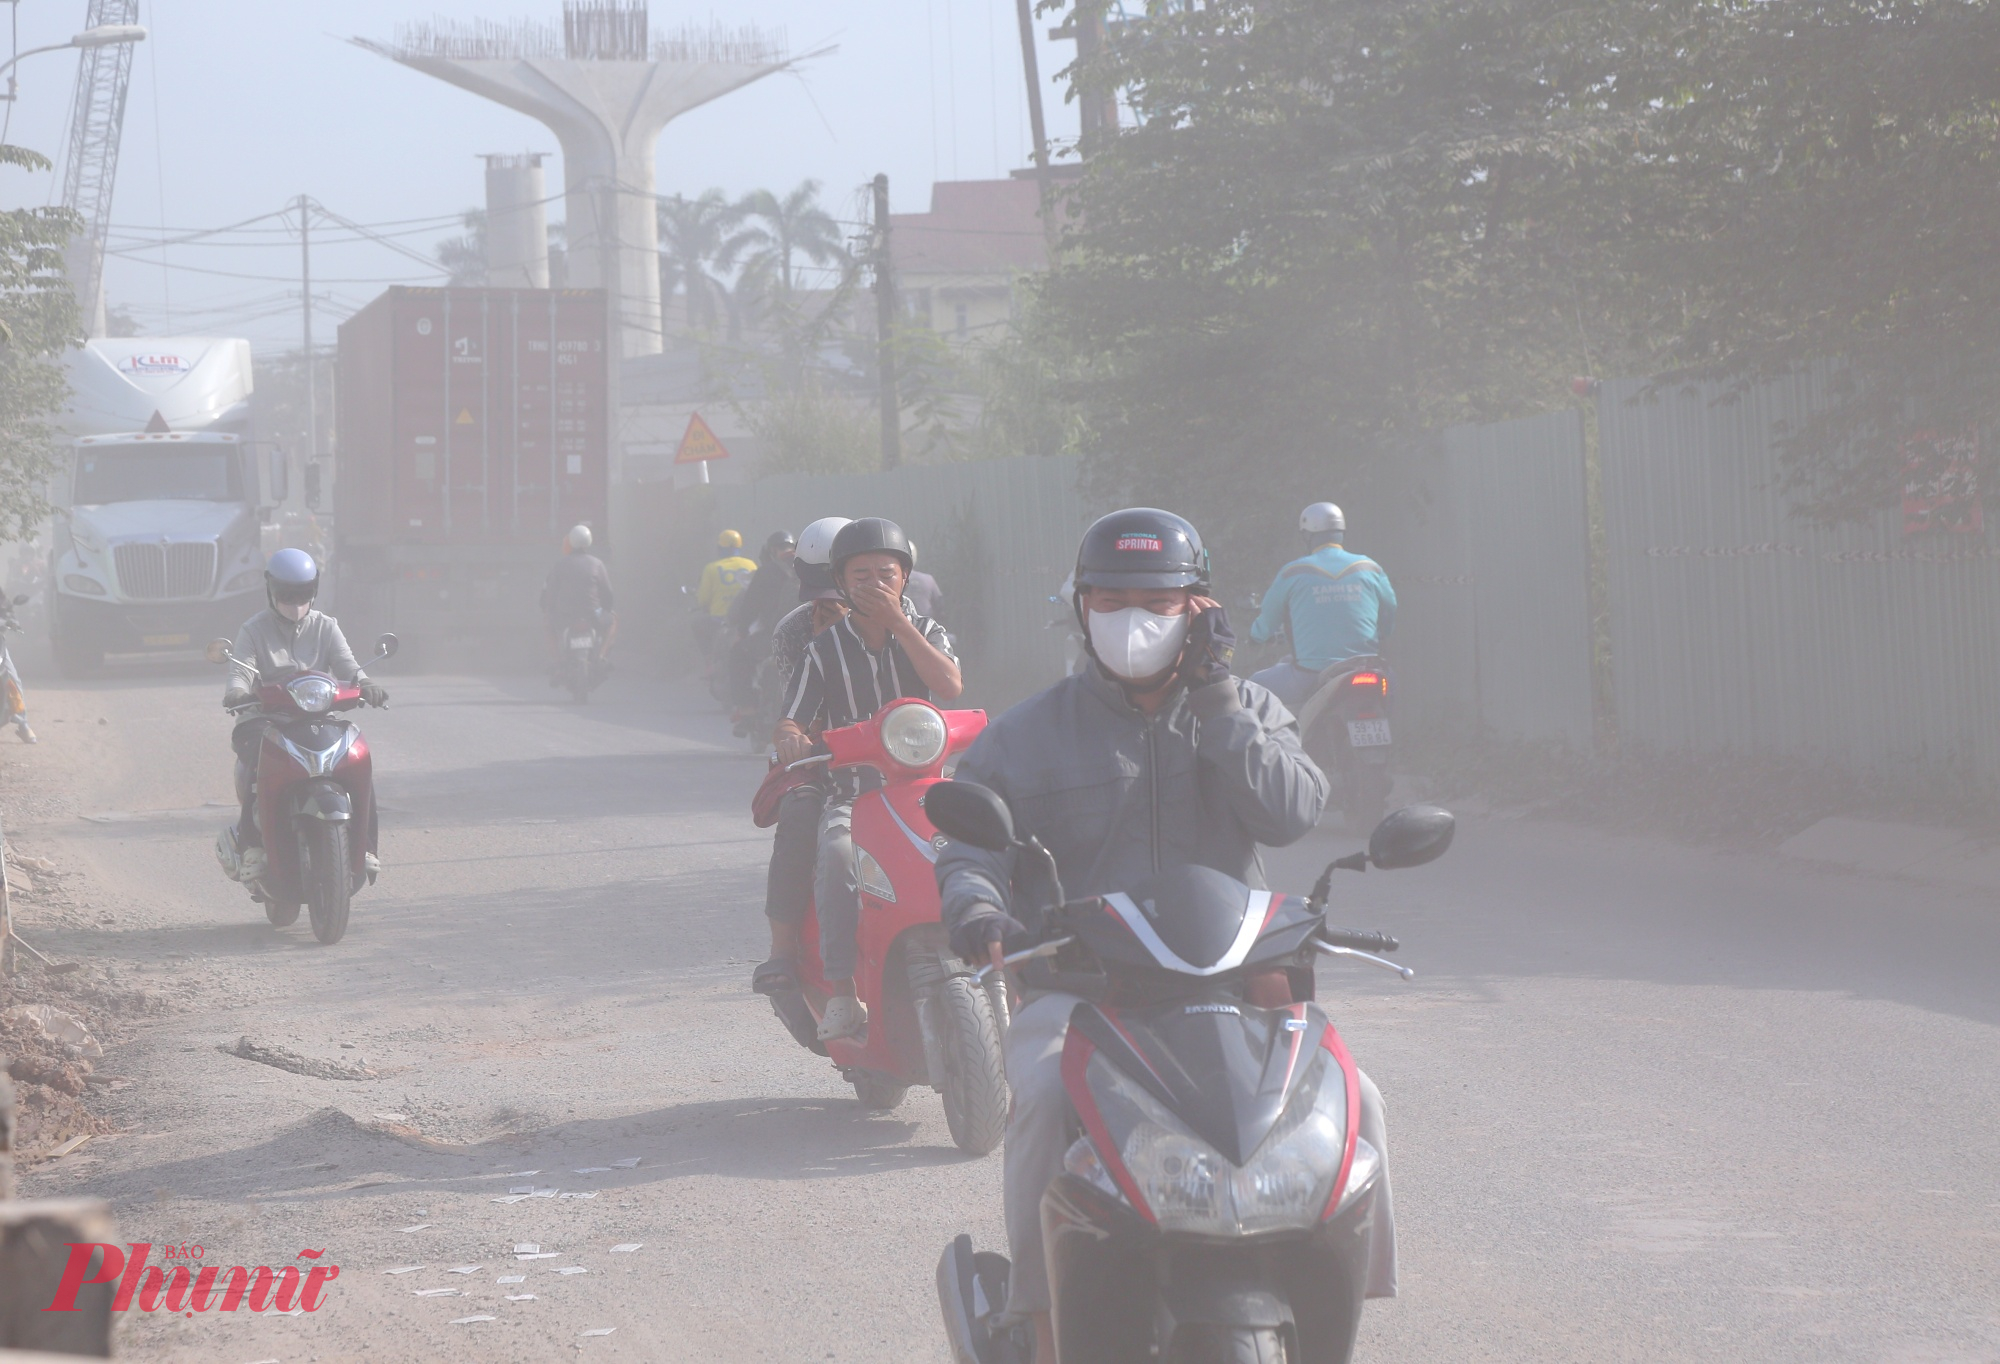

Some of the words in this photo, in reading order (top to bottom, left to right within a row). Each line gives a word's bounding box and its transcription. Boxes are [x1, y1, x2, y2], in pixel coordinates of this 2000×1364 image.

[557, 340, 588, 352] 459780
[557, 353, 577, 365] 45G1
[1118, 539, 1159, 550] SPRINTA
[1184, 1004, 1241, 1016] HONDA
